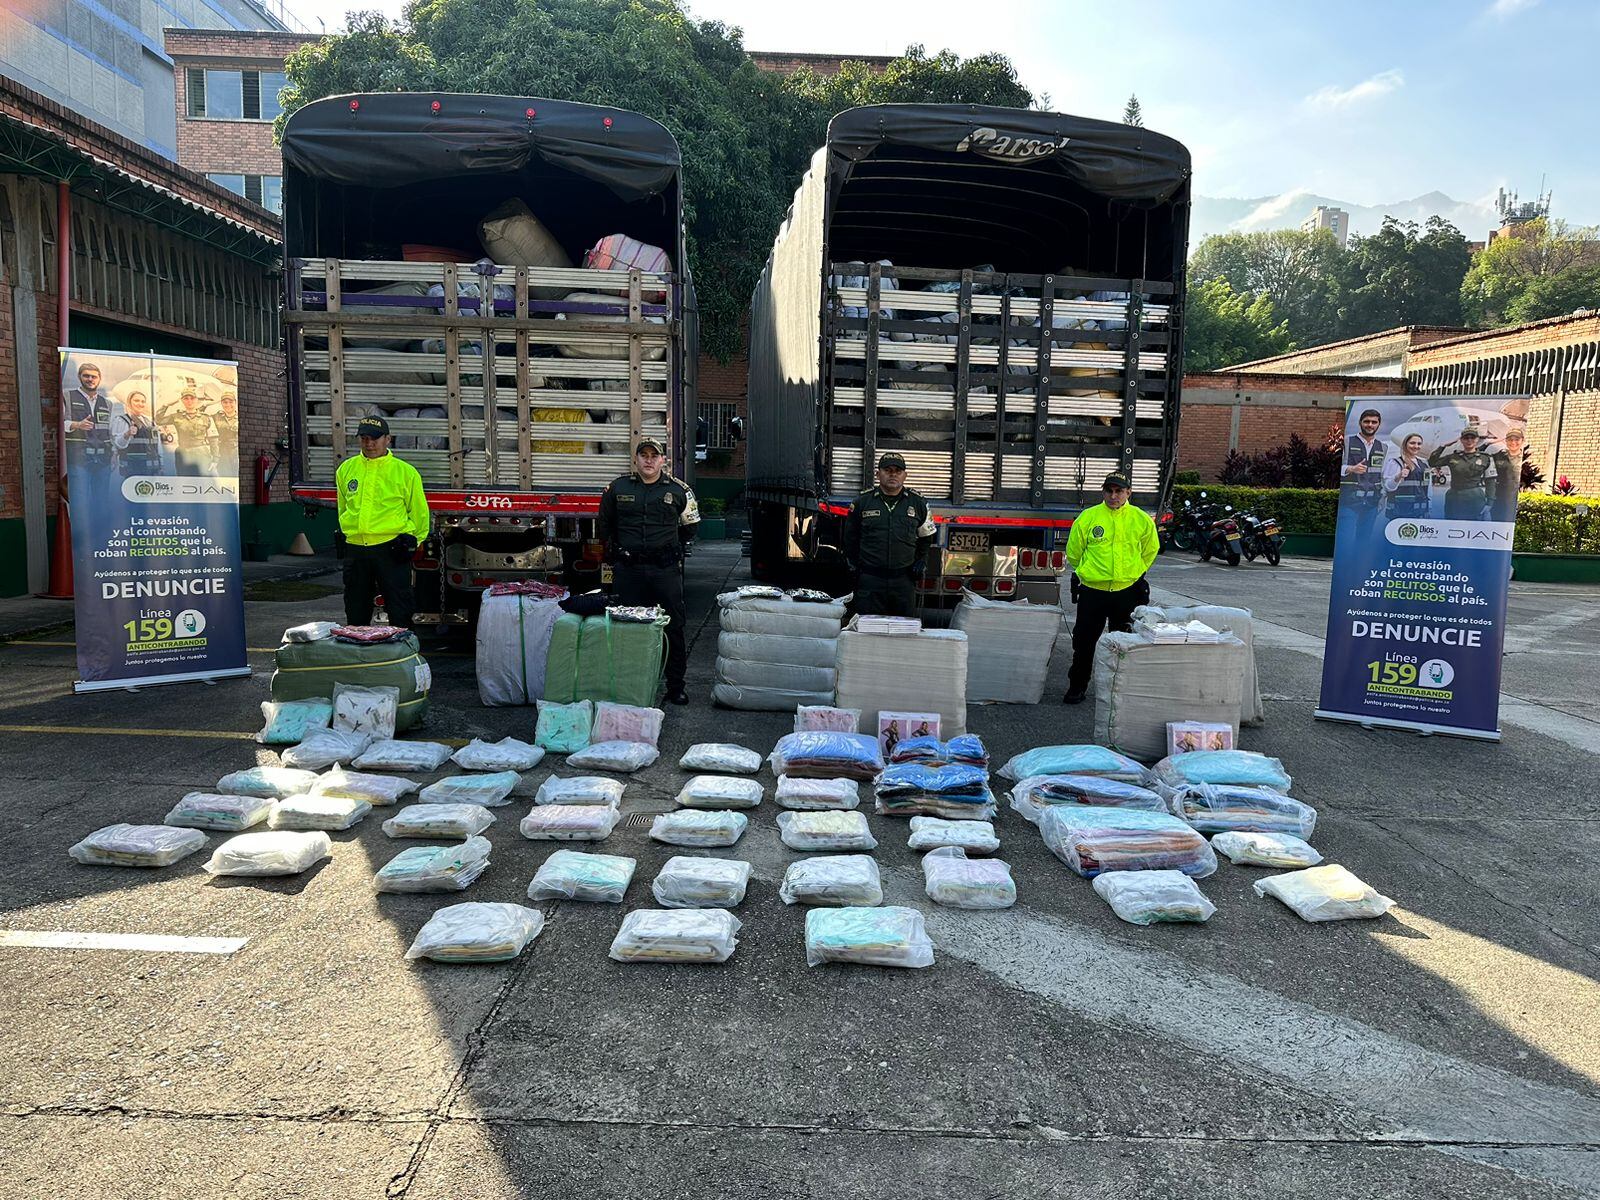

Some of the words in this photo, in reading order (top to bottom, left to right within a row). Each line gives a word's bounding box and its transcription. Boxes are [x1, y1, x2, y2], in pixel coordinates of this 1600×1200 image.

[155, 482, 170, 490] Dios
[182, 485, 235, 495] DIAN
[465, 496, 512, 508] SUTA
[131, 517, 143, 525] La
[147, 516, 189, 525] evasión
[113, 529, 120, 537] y
[123, 527, 134, 535] el
[137, 526, 206, 536] contrabando
[1420, 525, 1434, 534] Dios
[1447, 529, 1509, 541] DIAN
[108, 539, 128, 547] son
[130, 537, 179, 547] DELITOS
[180, 538, 200, 548] que
[202, 537, 212, 545] le
[950, 534, 989, 548] EST-012
[94, 549, 127, 558] roban
[129, 547, 189, 557] RECURSOS
[191, 547, 201, 555] al
[203, 546, 226, 556] país.
[1390, 559, 1403, 568] La
[1406, 559, 1450, 571] evasión
[94, 569, 131, 578] Ayúdenos
[138, 568, 170, 576] proteger
[179, 568, 192, 576] que
[1371, 570, 1377, 578] y
[1380, 569, 1391, 577] el
[1393, 570, 1469, 583] contrabando
[102, 578, 226, 600] DENUNCIE
[1364, 580, 1383, 588] son
[1386, 580, 1436, 591] DELITOS
[1438, 584, 1460, 593] que
[1463, 584, 1474, 593] le
[1349, 588, 1381, 598] roban
[1383, 590, 1446, 602] RECURSOS
[1448, 595, 1458, 603] al
[1461, 596, 1488, 606] país.
[140, 609, 171, 619] Línea
[1347, 609, 1382, 617] Ayúdenos
[1389, 612, 1422, 621] proteger
[1432, 616, 1447, 624] que
[1469, 618, 1492, 626] todos
[123, 618, 173, 642] 159
[1352, 620, 1482, 647] DENUNCIE
[128, 639, 206, 650] ANTICONTRABANDO
[145, 657, 179, 665] protegemos
[1385, 652, 1418, 663] Línea
[1367, 661, 1417, 685] 159
[1369, 684, 1451, 699] ANTICONTRABANDO
[1383, 702, 1419, 710] protegemos
